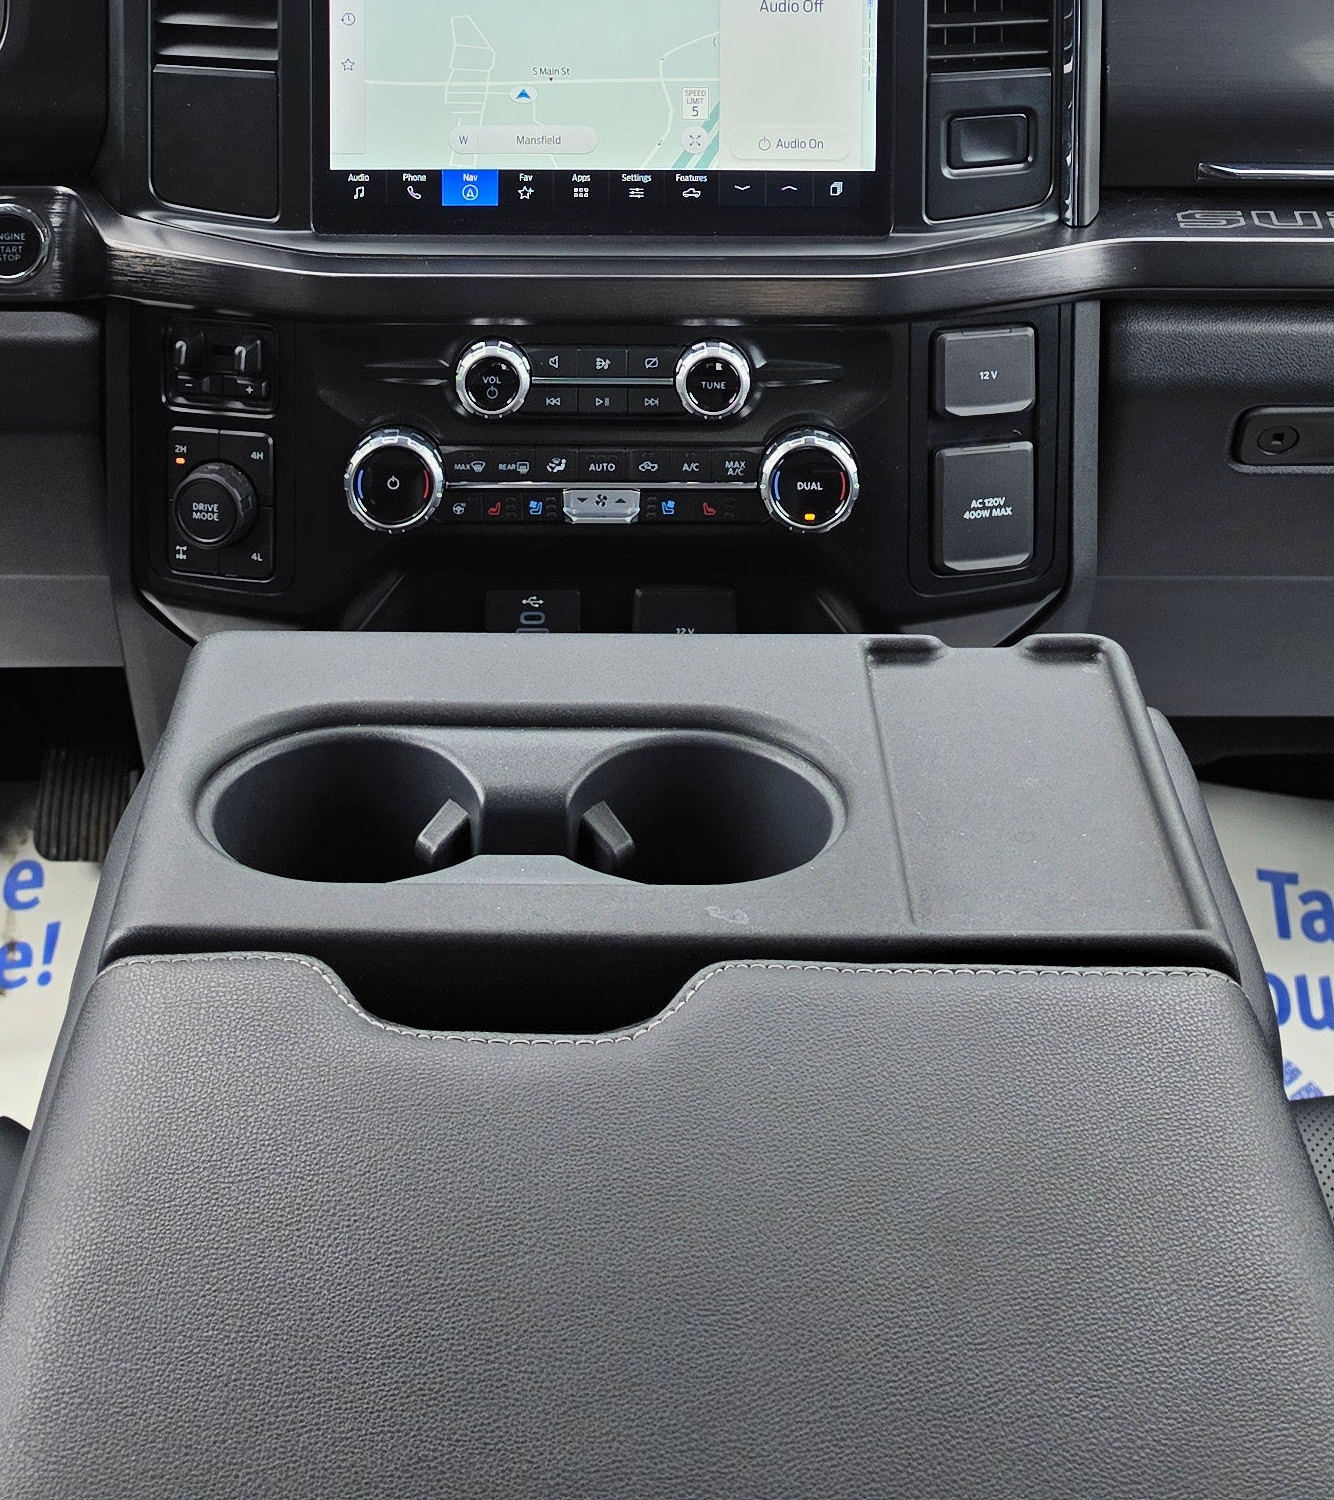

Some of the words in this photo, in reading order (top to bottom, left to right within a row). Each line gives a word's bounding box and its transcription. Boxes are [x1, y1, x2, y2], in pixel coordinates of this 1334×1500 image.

[532, 66, 539, 76] S
[539, 66, 559, 76] Main
[560, 66, 571, 76] St
[684, 89, 707, 98] SPEED
[685, 97, 705, 106] LIMIT
[690, 105, 700, 118] 5
[458, 134, 469, 146] W
[515, 133, 562, 147] Mansfield
[775, 137, 804, 151] Audio
[806, 137, 825, 151] On
[347, 172, 370, 183] Audio
[401, 172, 428, 182] Phone
[462, 172, 479, 182] Nav
[518, 172, 534, 182] Fav
[571, 172, 592, 185] Apps
[620, 172, 653, 185] Settings
[674, 172, 709, 183] Features
[482, 375, 502, 386] VOL
[700, 380, 727, 391] TUNE
[174, 444, 187, 454] 2H
[250, 451, 265, 461] 4H
[453, 462, 471, 472] MAX
[498, 462, 518, 472] REAR
[588, 461, 617, 473] AUTO
[682, 461, 701, 473] A/C
[725, 460, 747, 470] MAX
[726, 468, 746, 477] A/C
[796, 481, 824, 492] DUAL
[192, 502, 219, 513] DRIVE
[969, 498, 984, 509] AC
[983, 496, 1007, 508] 120V
[192, 511, 220, 522] MODE
[963, 509, 991, 521] 400W
[991, 506, 1013, 519] MAX
[251, 552, 264, 562] 4L
